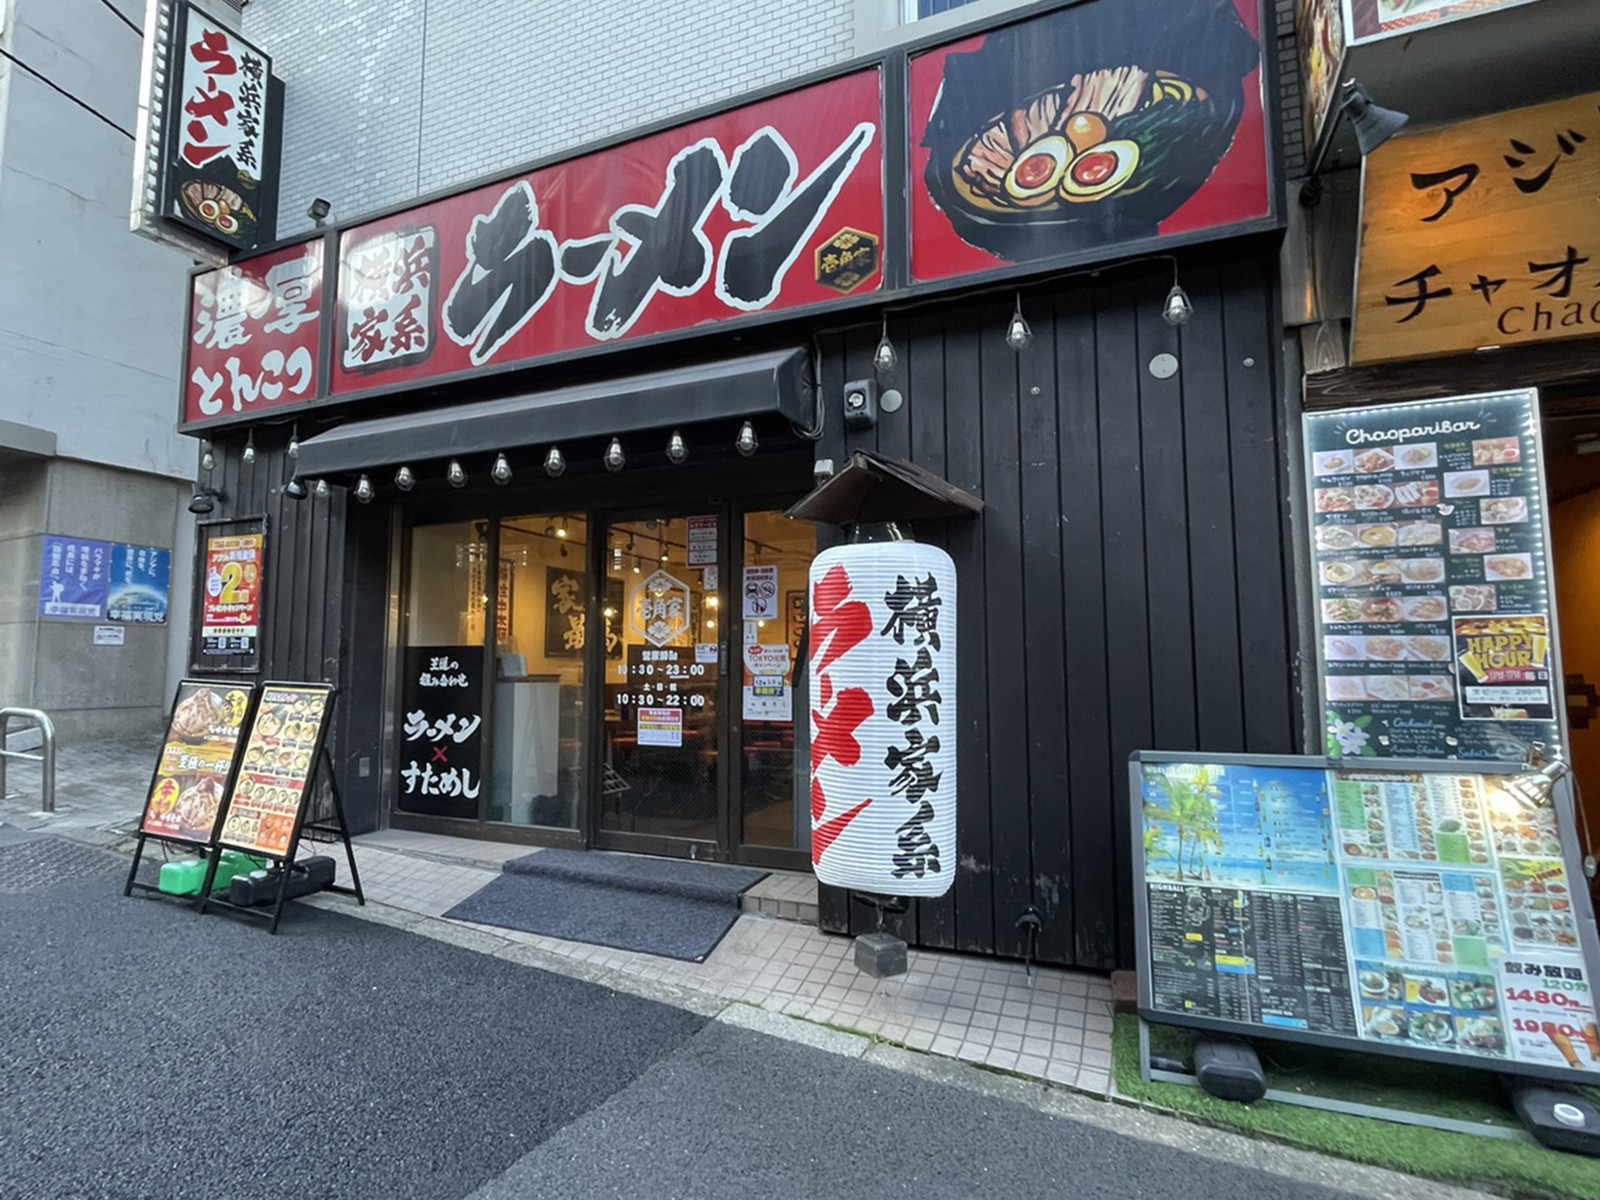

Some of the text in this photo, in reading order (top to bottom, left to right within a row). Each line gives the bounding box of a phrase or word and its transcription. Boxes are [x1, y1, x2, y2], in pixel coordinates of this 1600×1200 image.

[185, 28, 237, 165] ラーメン
[236, 52, 264, 170] 横浜家系
[1410, 106, 1600, 222] アジ
[350, 234, 432, 304] 横浜
[442, 122, 876, 366] ラーメン
[193, 256, 320, 349] 濃厚
[1385, 245, 1600, 323] チャオ
[350, 293, 426, 363] 家系
[191, 346, 313, 415] とんこつ
[637, 596, 684, 620] 壱角家
[429, 656, 460, 671] 王道の
[1466, 633, 1532, 654] HAPPY
[1474, 649, 1531, 669] HOUR
[419, 673, 469, 688] 組み合わせ
[809, 562, 874, 867] ラーメン
[403, 709, 482, 743] ラーメン
[880, 571, 942, 880] 横浜家系
[400, 760, 481, 799] すためし
[1504, 961, 1583, 981] 飲み放題
